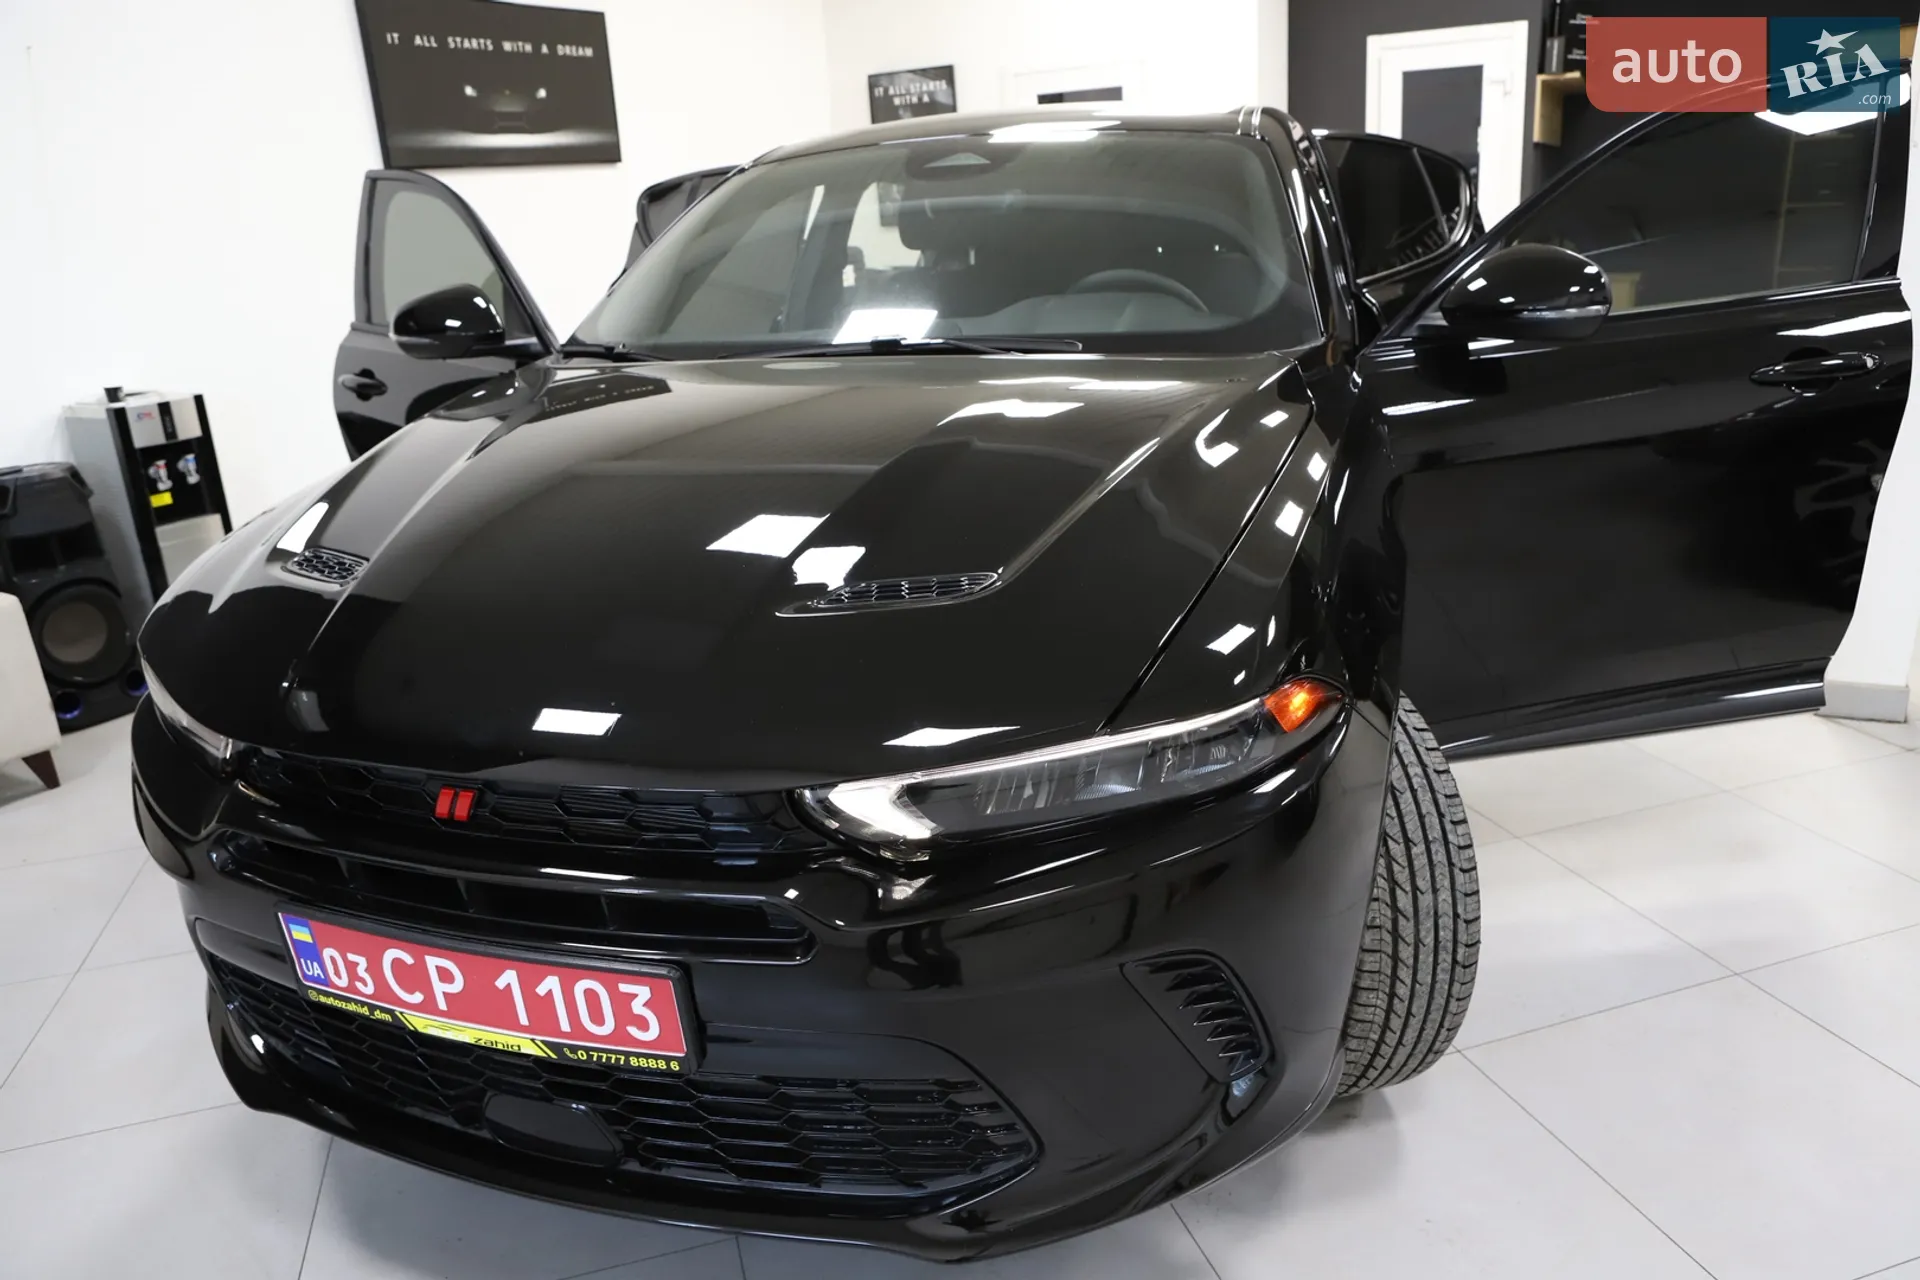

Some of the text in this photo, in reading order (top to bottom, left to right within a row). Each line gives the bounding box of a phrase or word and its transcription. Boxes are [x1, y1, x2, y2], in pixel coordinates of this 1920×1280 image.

[386, 32, 594, 57] IT ALL STARTS WITH A DREAM
[874, 79, 948, 97] IT ALL STARTS
[893, 92, 930, 106] WITH A
[300, 958, 325, 979] UA
[323, 947, 661, 1042] 03 CP 1103
[473, 1036, 522, 1051] zahid
[589, 1052, 625, 1065] 7777
[629, 1056, 667, 1070] 8888
[670, 1061, 680, 1071] 6
